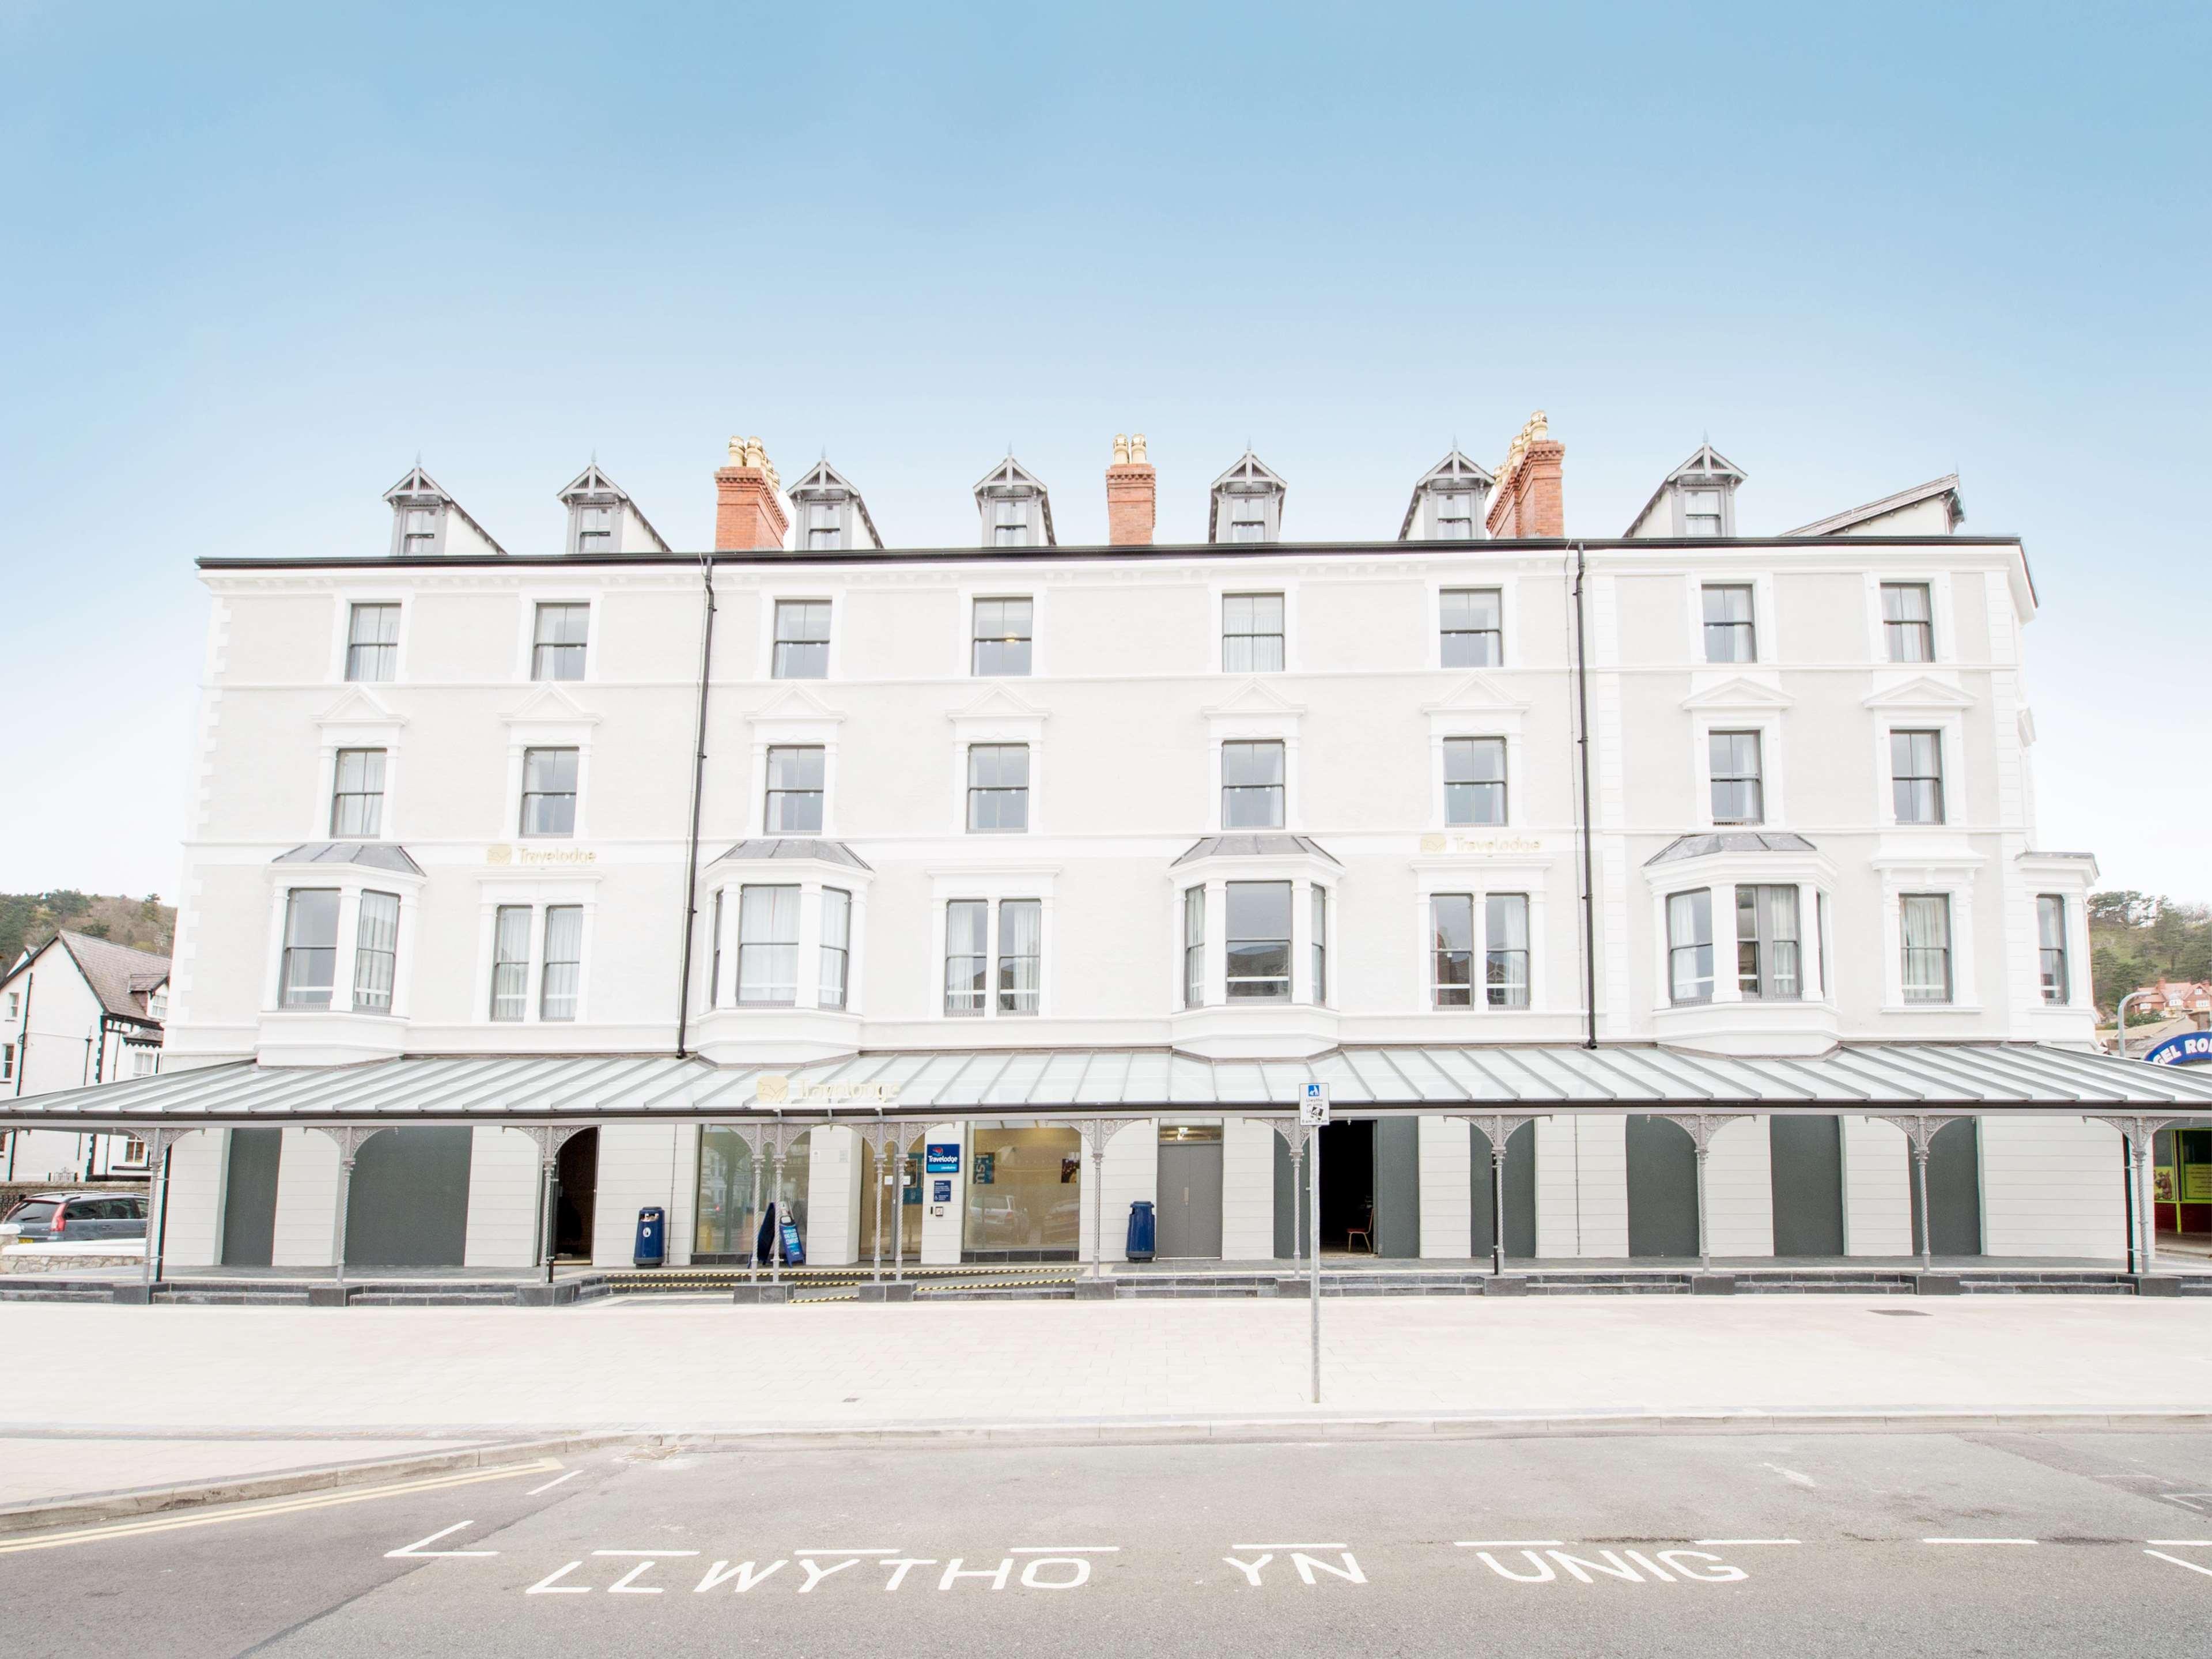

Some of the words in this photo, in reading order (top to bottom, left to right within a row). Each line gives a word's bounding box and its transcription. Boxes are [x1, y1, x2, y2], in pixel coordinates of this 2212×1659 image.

[1453, 836, 1541, 853] Travelodge
[517, 847, 596, 864] Travelodge
[799, 1078, 900, 1102] Travelodge
[928, 1155, 958, 1163] Travelodge
[525, 1558, 1091, 1594] LLWYTHO
[1222, 1552, 1368, 1586] YN
[1476, 1550, 1749, 1584] UNIG
